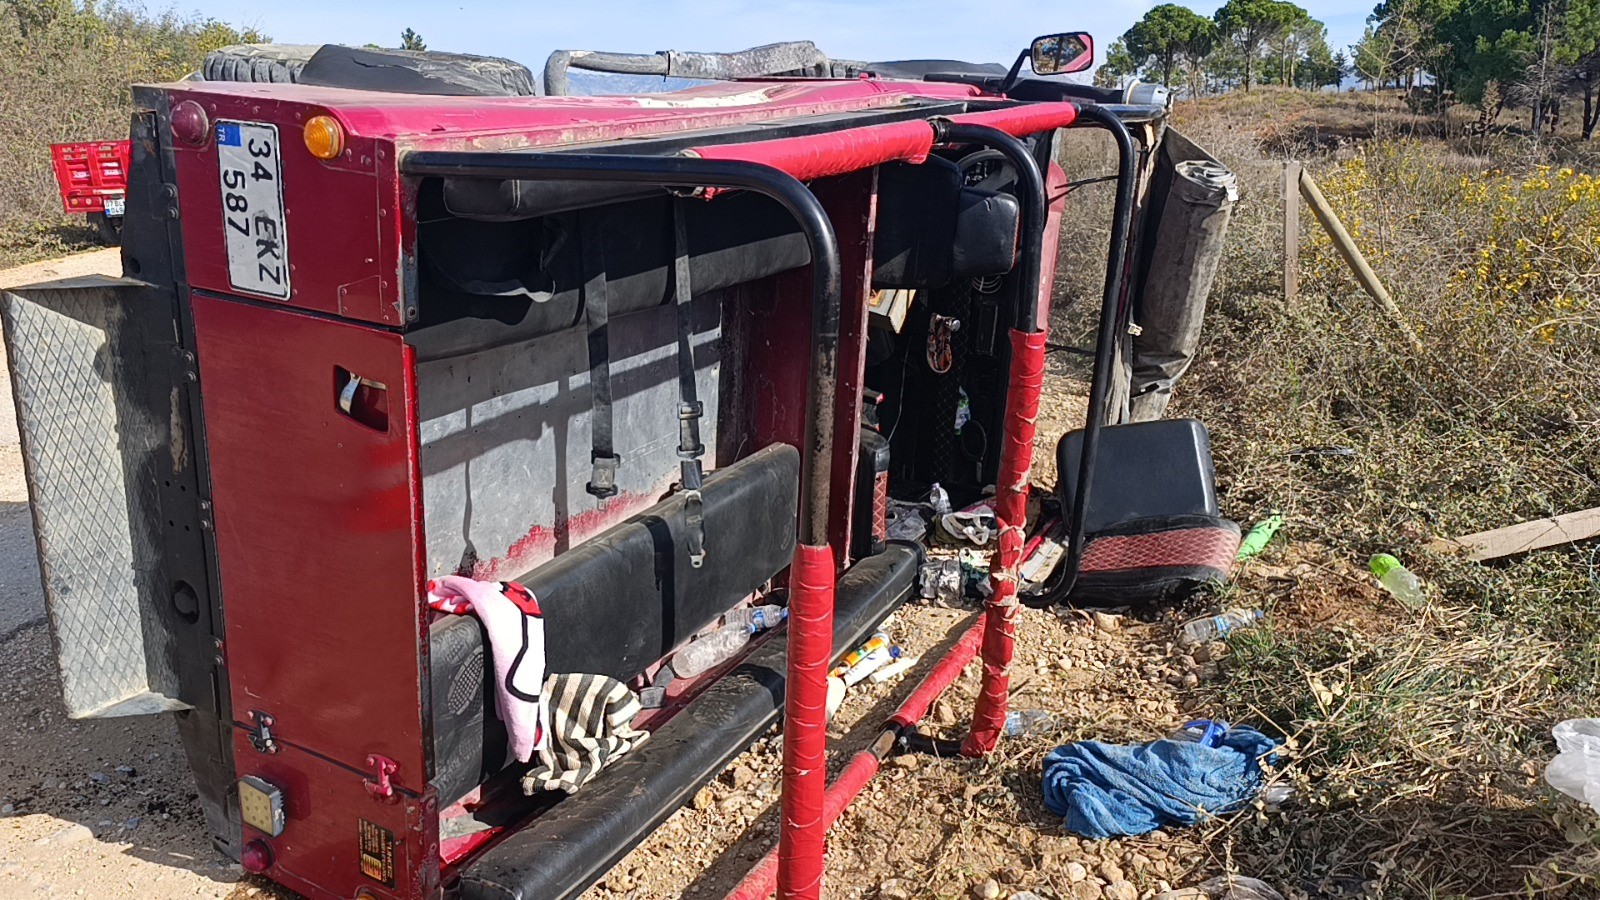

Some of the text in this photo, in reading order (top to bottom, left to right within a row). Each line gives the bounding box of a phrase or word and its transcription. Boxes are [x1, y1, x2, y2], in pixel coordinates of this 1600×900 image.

[218, 127, 225, 142] TR
[222, 168, 250, 237] 587
[248, 138, 281, 286] 34 EKZ
